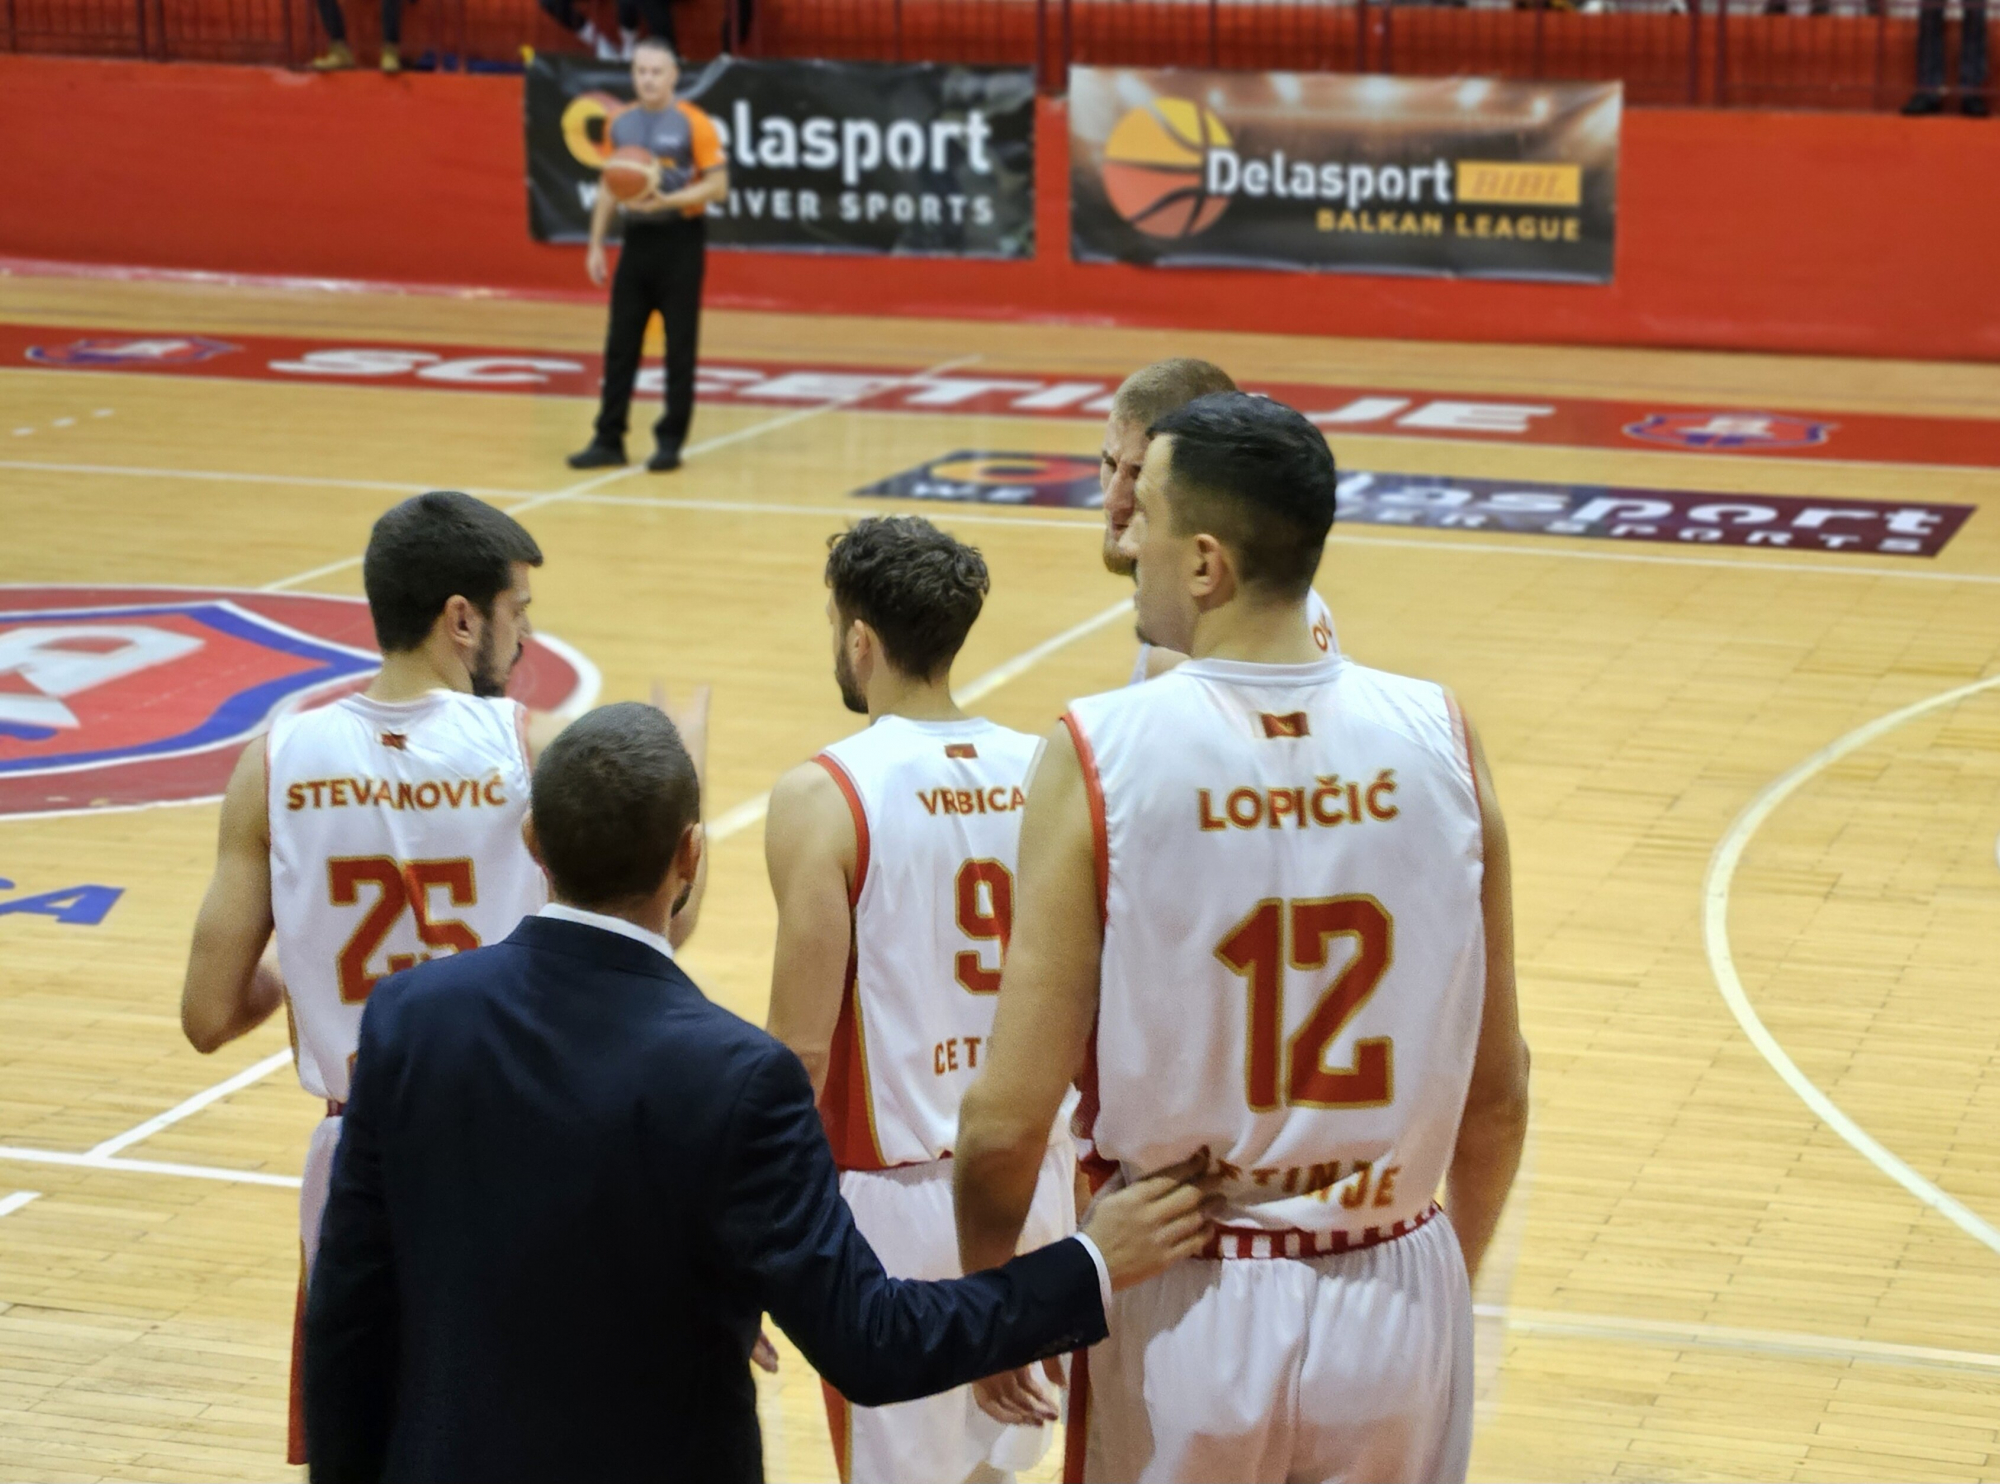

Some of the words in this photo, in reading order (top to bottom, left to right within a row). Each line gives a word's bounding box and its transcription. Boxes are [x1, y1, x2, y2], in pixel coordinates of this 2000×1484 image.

[1207, 149, 1452, 208] Delasport
[839, 194, 994, 226] SPORTS
[1316, 208, 1442, 234] BALKAN
[1455, 213, 1580, 241] LEAGUE
[268, 348, 586, 384] SC
[286, 766, 508, 812] STEVANOVIĆ
[916, 786, 1026, 817] VRBICA
[1196, 768, 1400, 832] LOPIČIĆ
[954, 857, 1015, 996] 9
[1213, 893, 1395, 1114] 12
